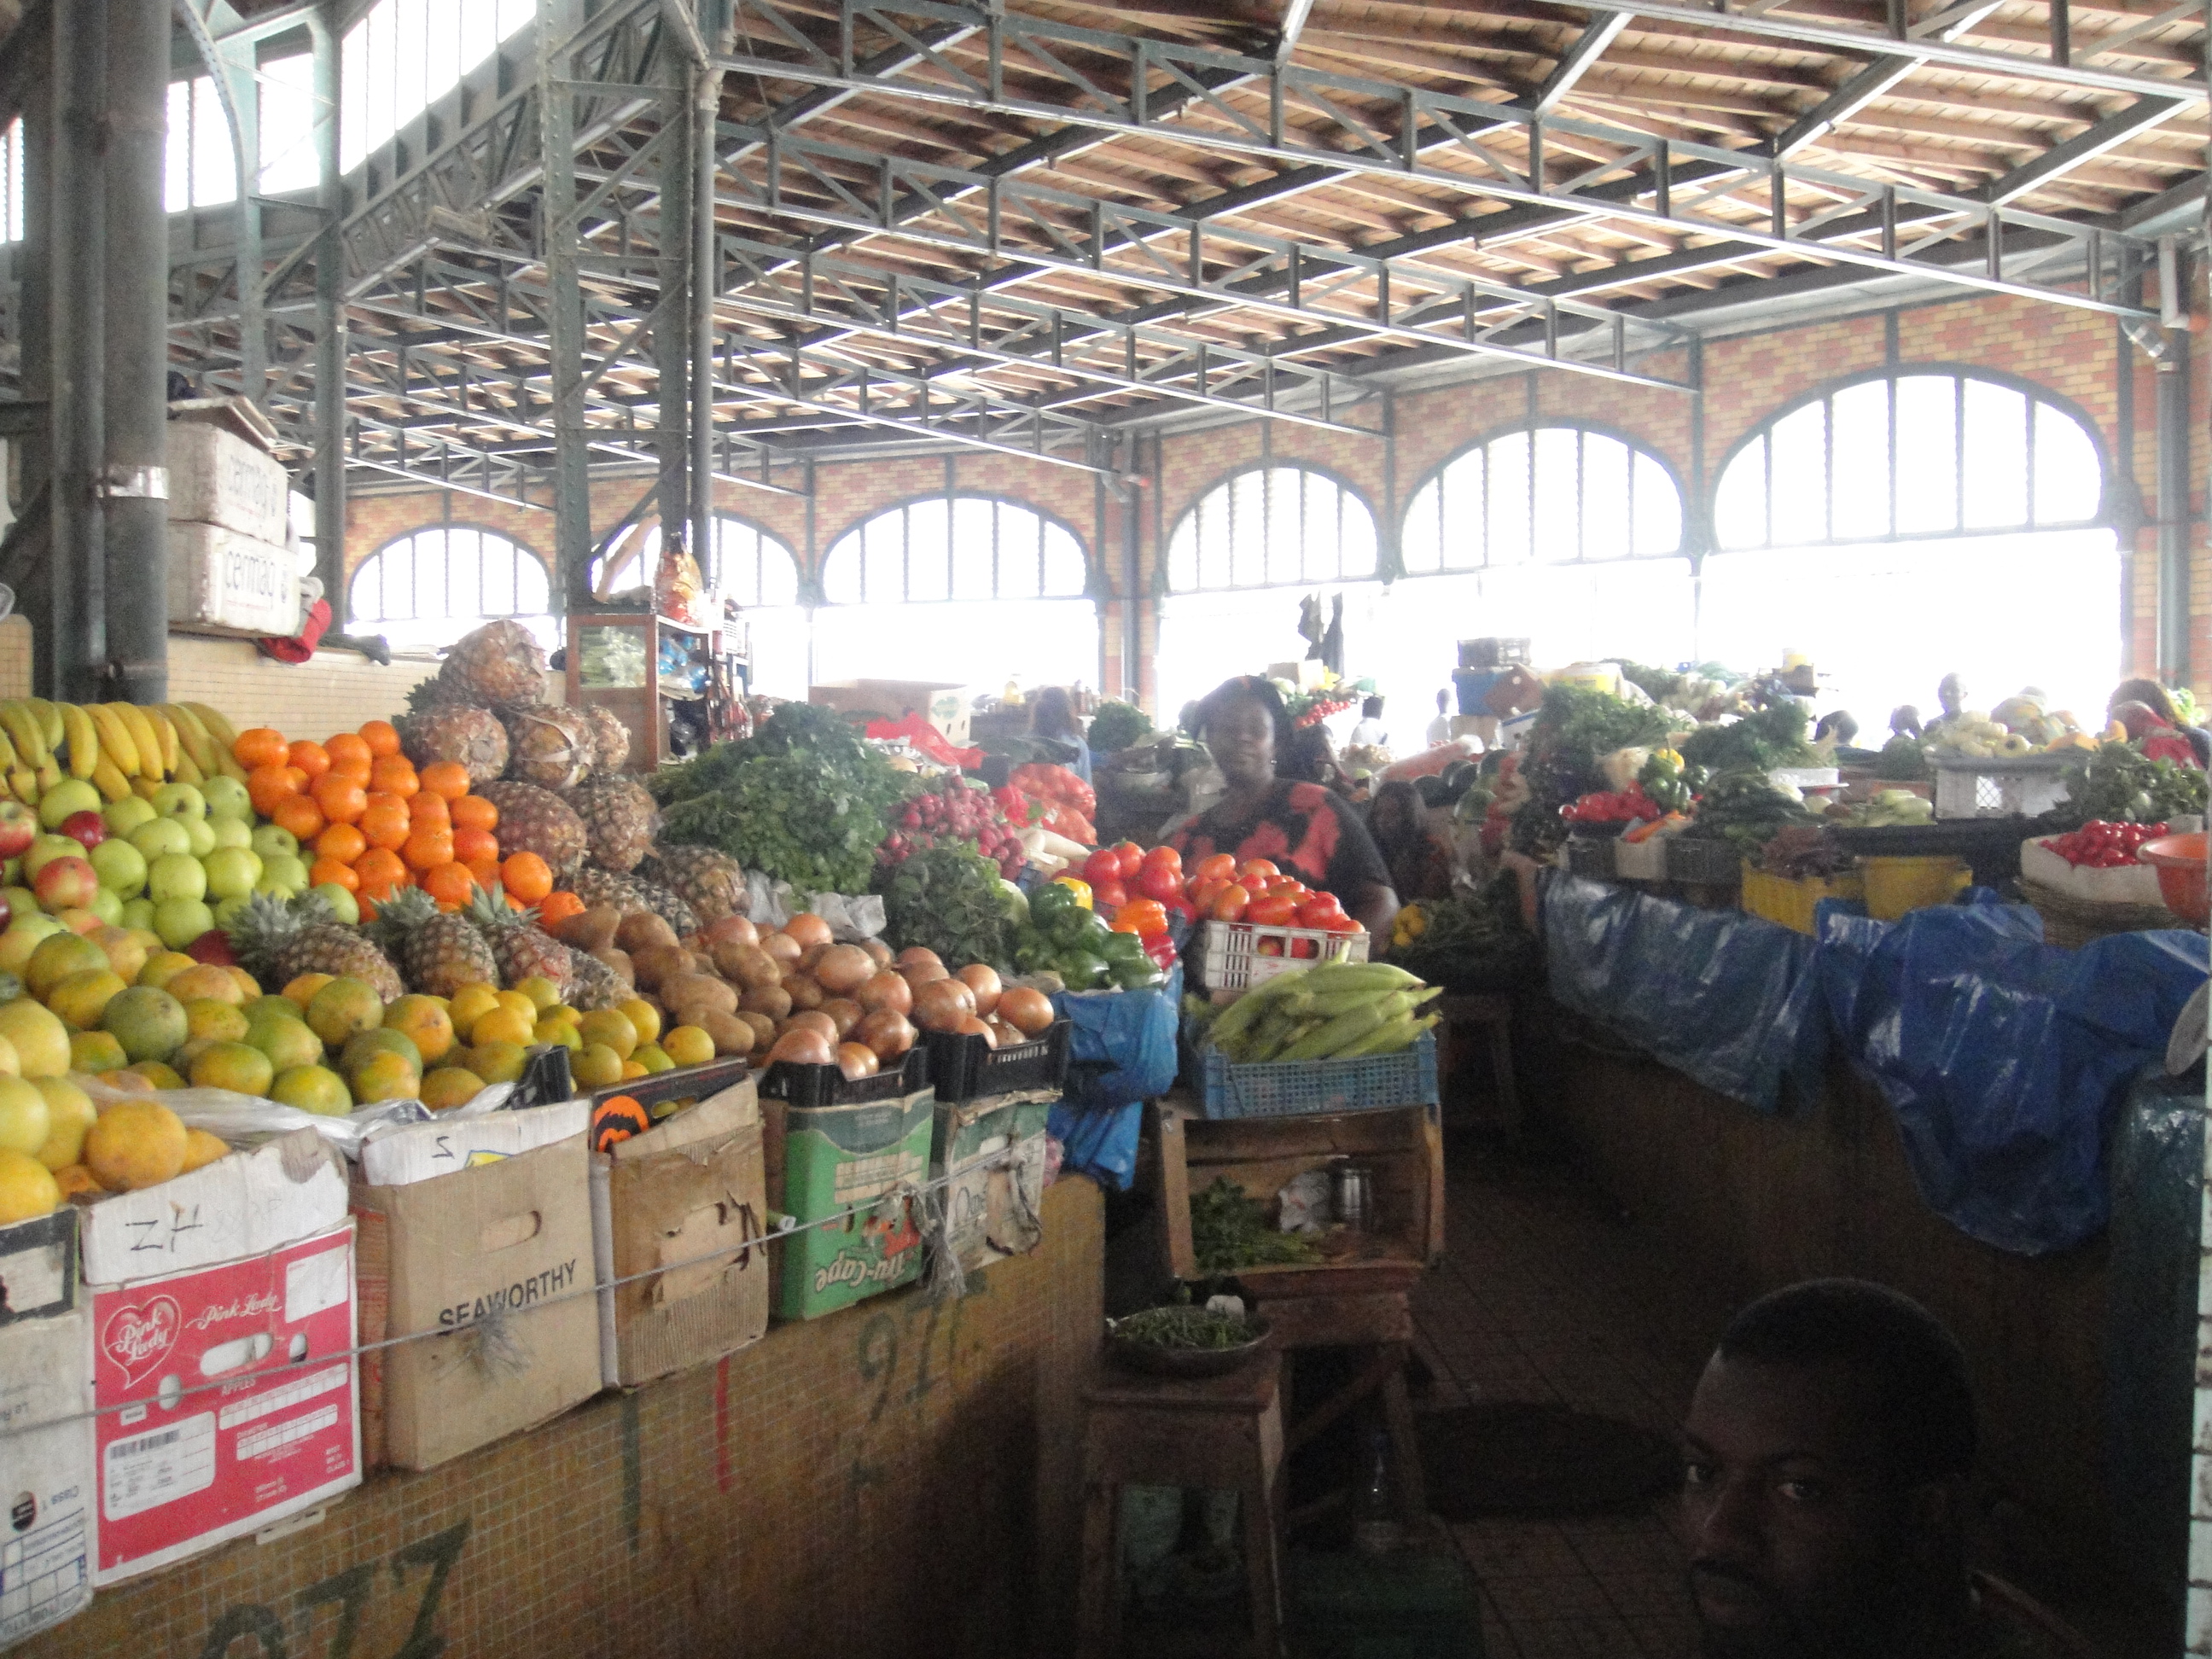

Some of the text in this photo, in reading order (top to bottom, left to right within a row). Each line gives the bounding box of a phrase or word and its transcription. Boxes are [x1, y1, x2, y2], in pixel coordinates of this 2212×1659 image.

[437, 1258, 577, 1328] SEAWORTHY
[115, 1309, 162, 1353] Pink
[126, 1328, 170, 1365] Lady
